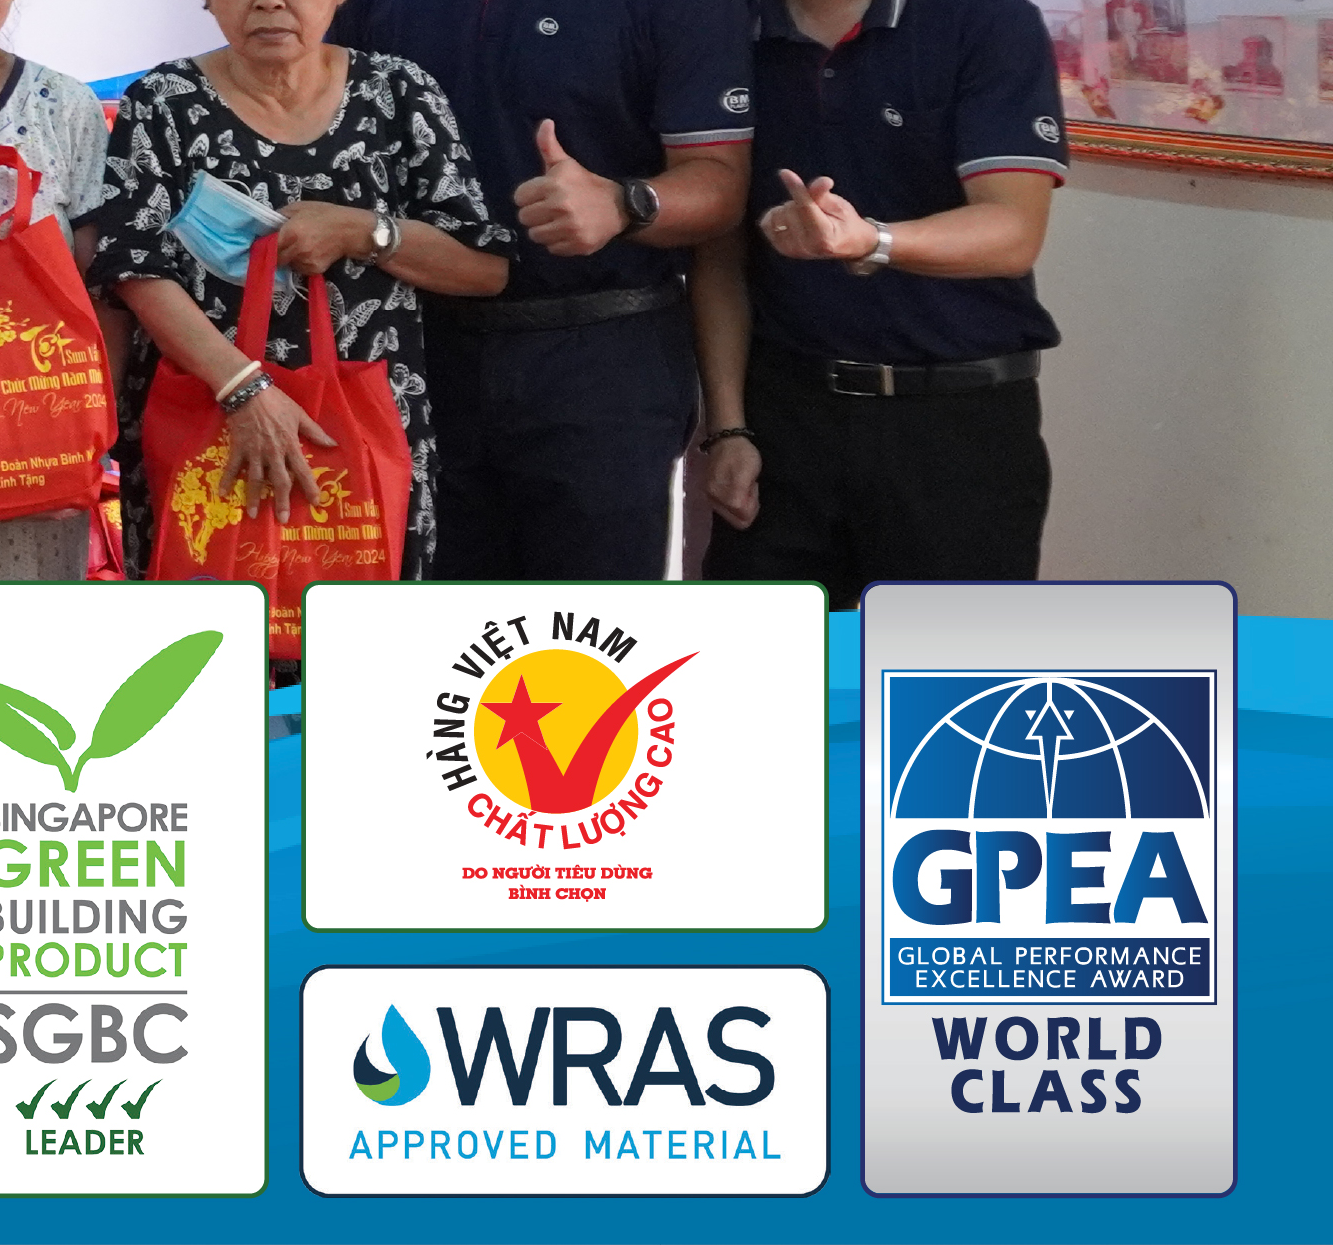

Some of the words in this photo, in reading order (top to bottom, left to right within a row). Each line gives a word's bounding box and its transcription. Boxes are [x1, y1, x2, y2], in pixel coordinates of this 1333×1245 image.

[84, 394, 107, 409] 2024
[1, 459, 27, 472] Đoàn
[30, 456, 58, 470] Nhựa
[19, 474, 45, 488] Tặng
[356, 549, 385, 564] 2024
